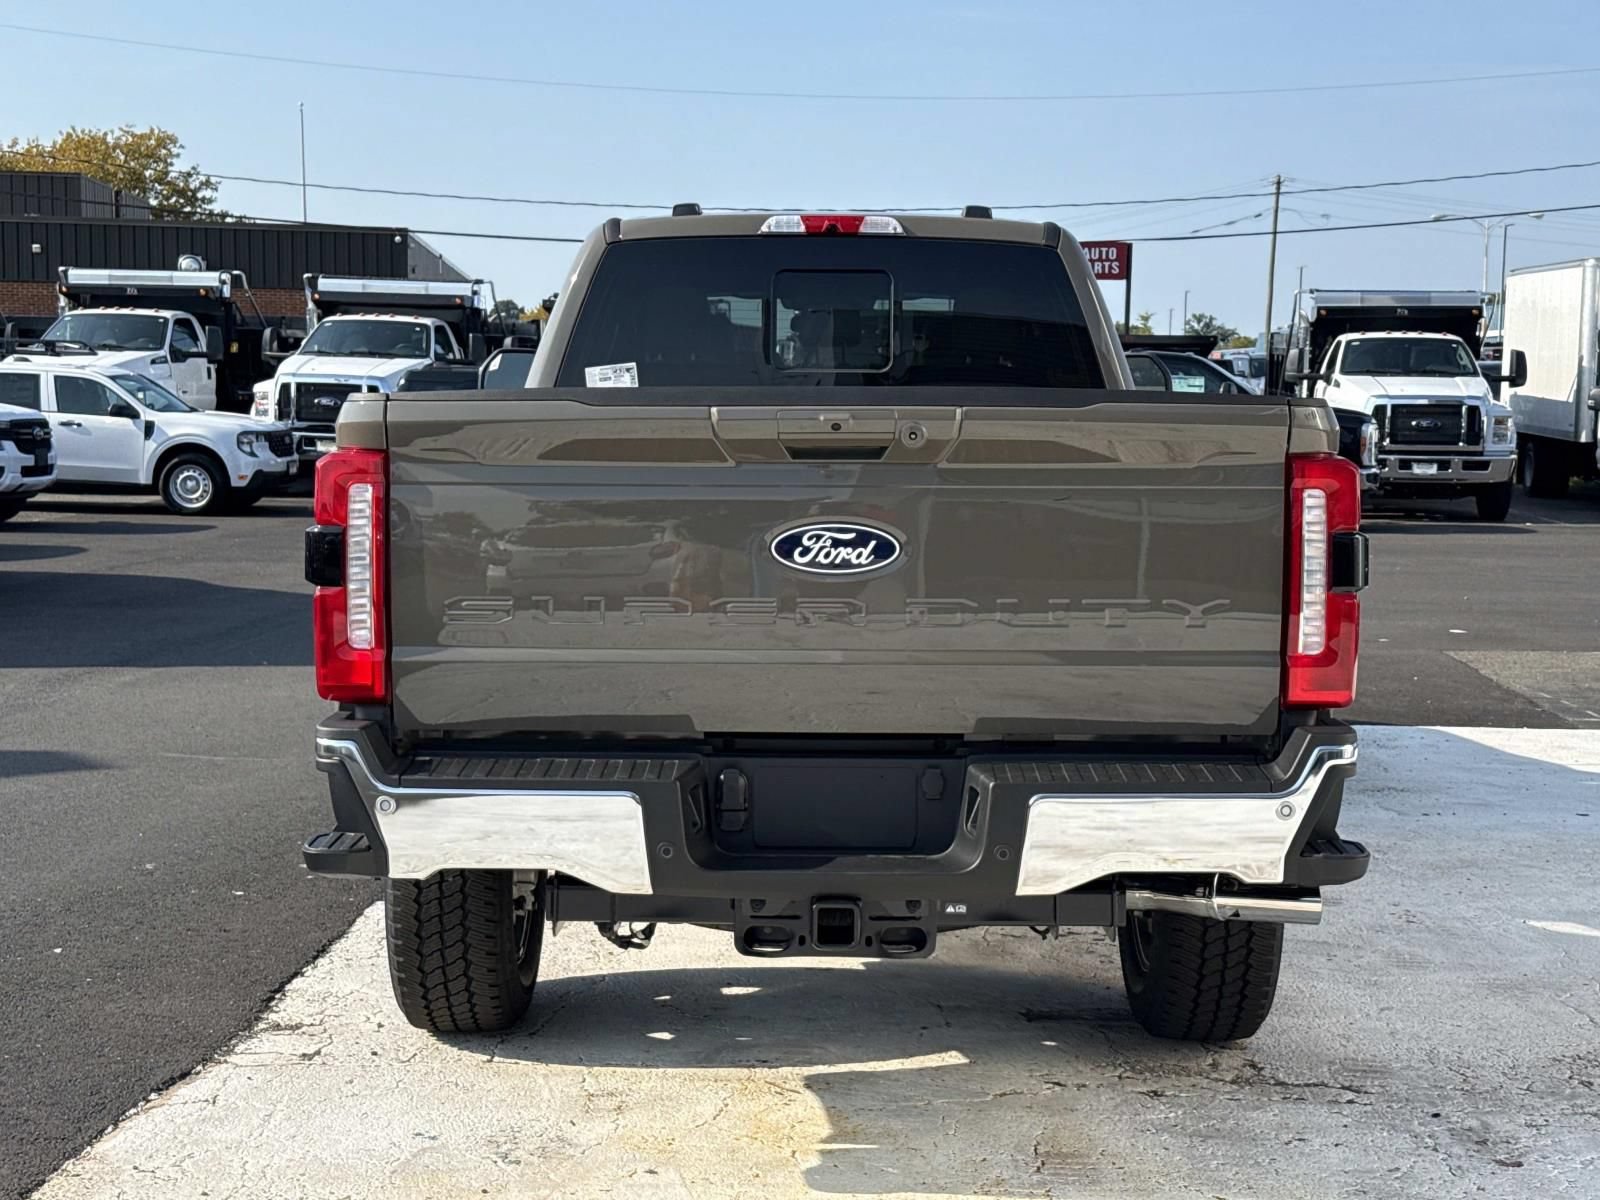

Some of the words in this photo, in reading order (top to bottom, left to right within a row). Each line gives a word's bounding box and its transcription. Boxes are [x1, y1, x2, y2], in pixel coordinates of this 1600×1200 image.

[1093, 261, 1120, 274] RTS
[793, 530, 877, 565] Ford
[443, 596, 867, 627] SUPER
[905, 598, 1231, 628] DUTY
